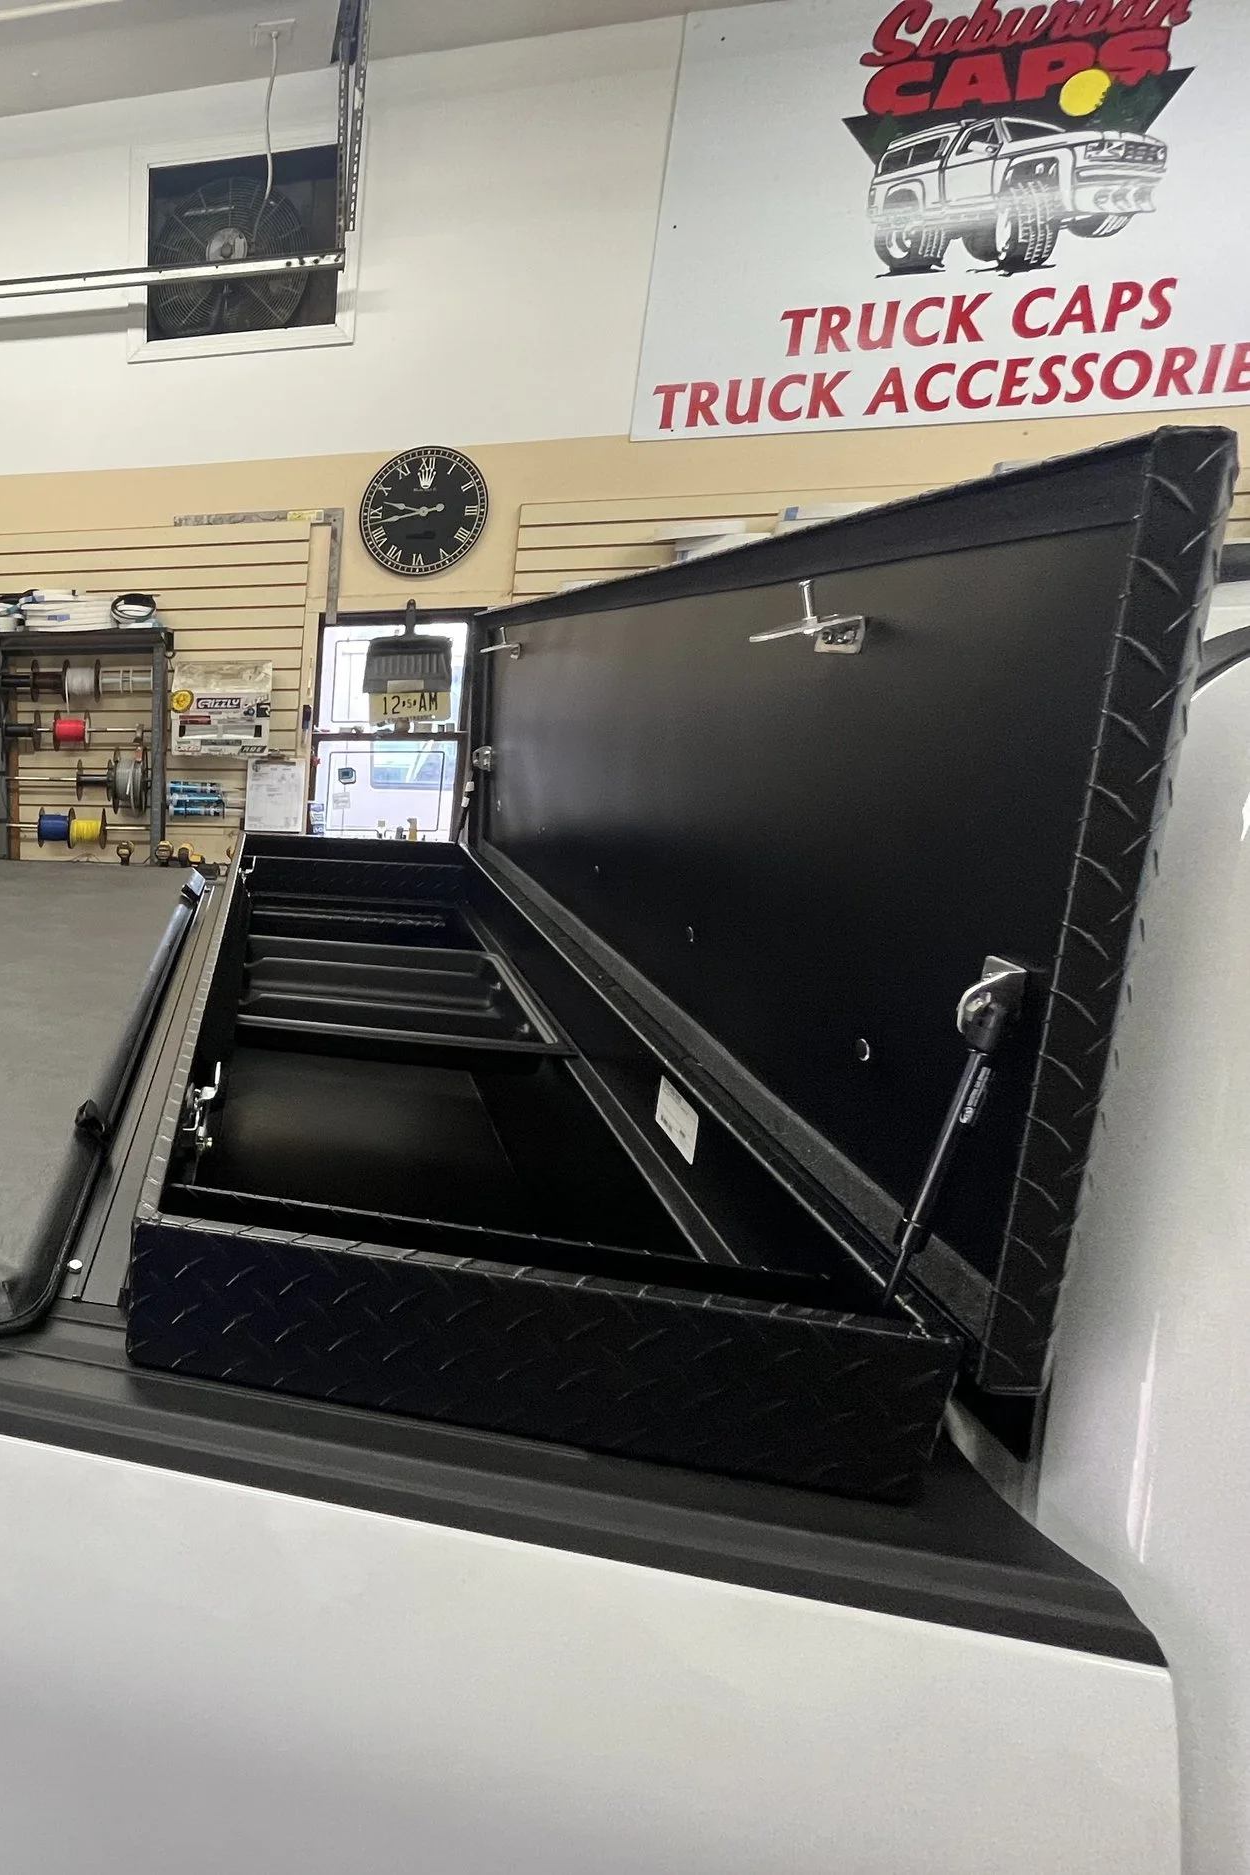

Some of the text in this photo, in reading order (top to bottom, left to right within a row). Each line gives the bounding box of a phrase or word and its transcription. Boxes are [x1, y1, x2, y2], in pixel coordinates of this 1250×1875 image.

[859, 0, 1193, 67] Suburban
[862, 27, 1171, 116] CAPS
[780, 277, 1178, 357] TRUCK CAPS
[653, 341, 1250, 430] TRUCK ACCESSORIE
[197, 698, 240, 709] GRIZZLY
